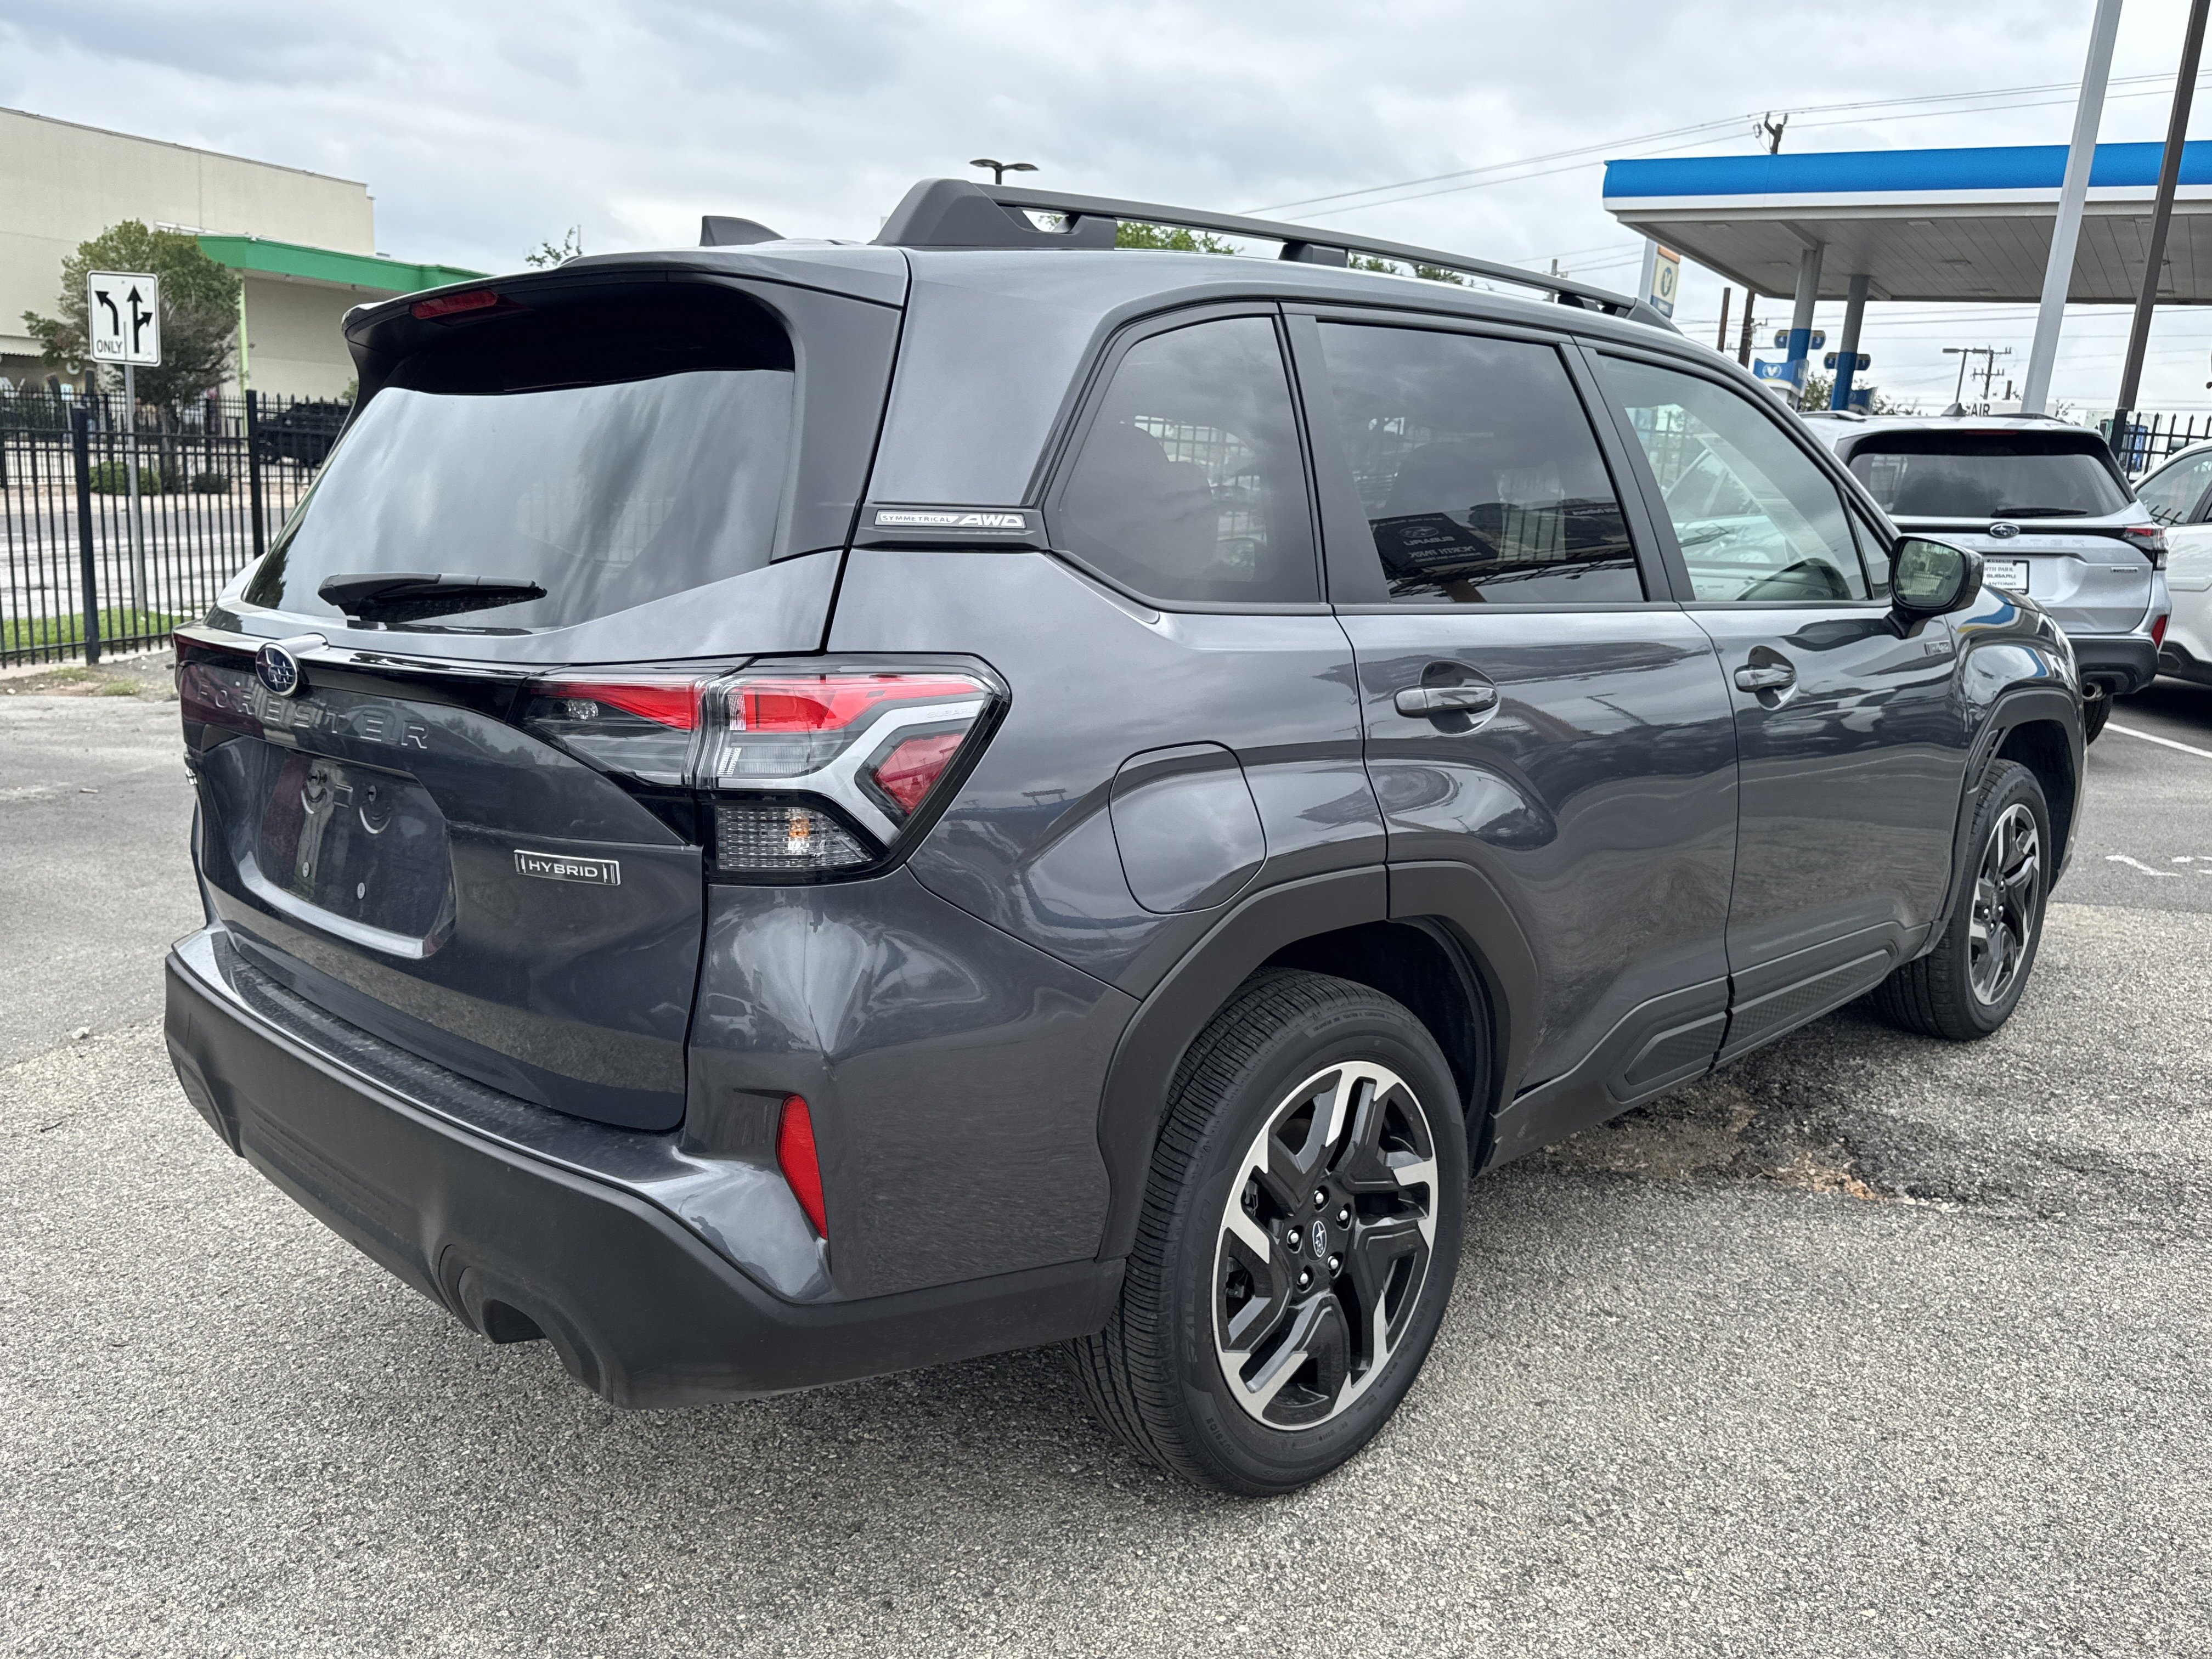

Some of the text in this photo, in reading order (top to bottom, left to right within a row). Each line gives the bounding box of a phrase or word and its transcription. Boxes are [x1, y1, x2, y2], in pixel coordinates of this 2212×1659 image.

[97, 339, 122, 354] ONLY
[1971, 403, 1990, 416] AIR
[882, 514, 1023, 527] SYMMETRICAL AWD
[196, 676, 430, 749] FORESTER
[927, 706, 977, 718] SUBARU
[528, 860, 598, 877] HYBRID
[1206, 1417, 1234, 1455] OUTSIDE
